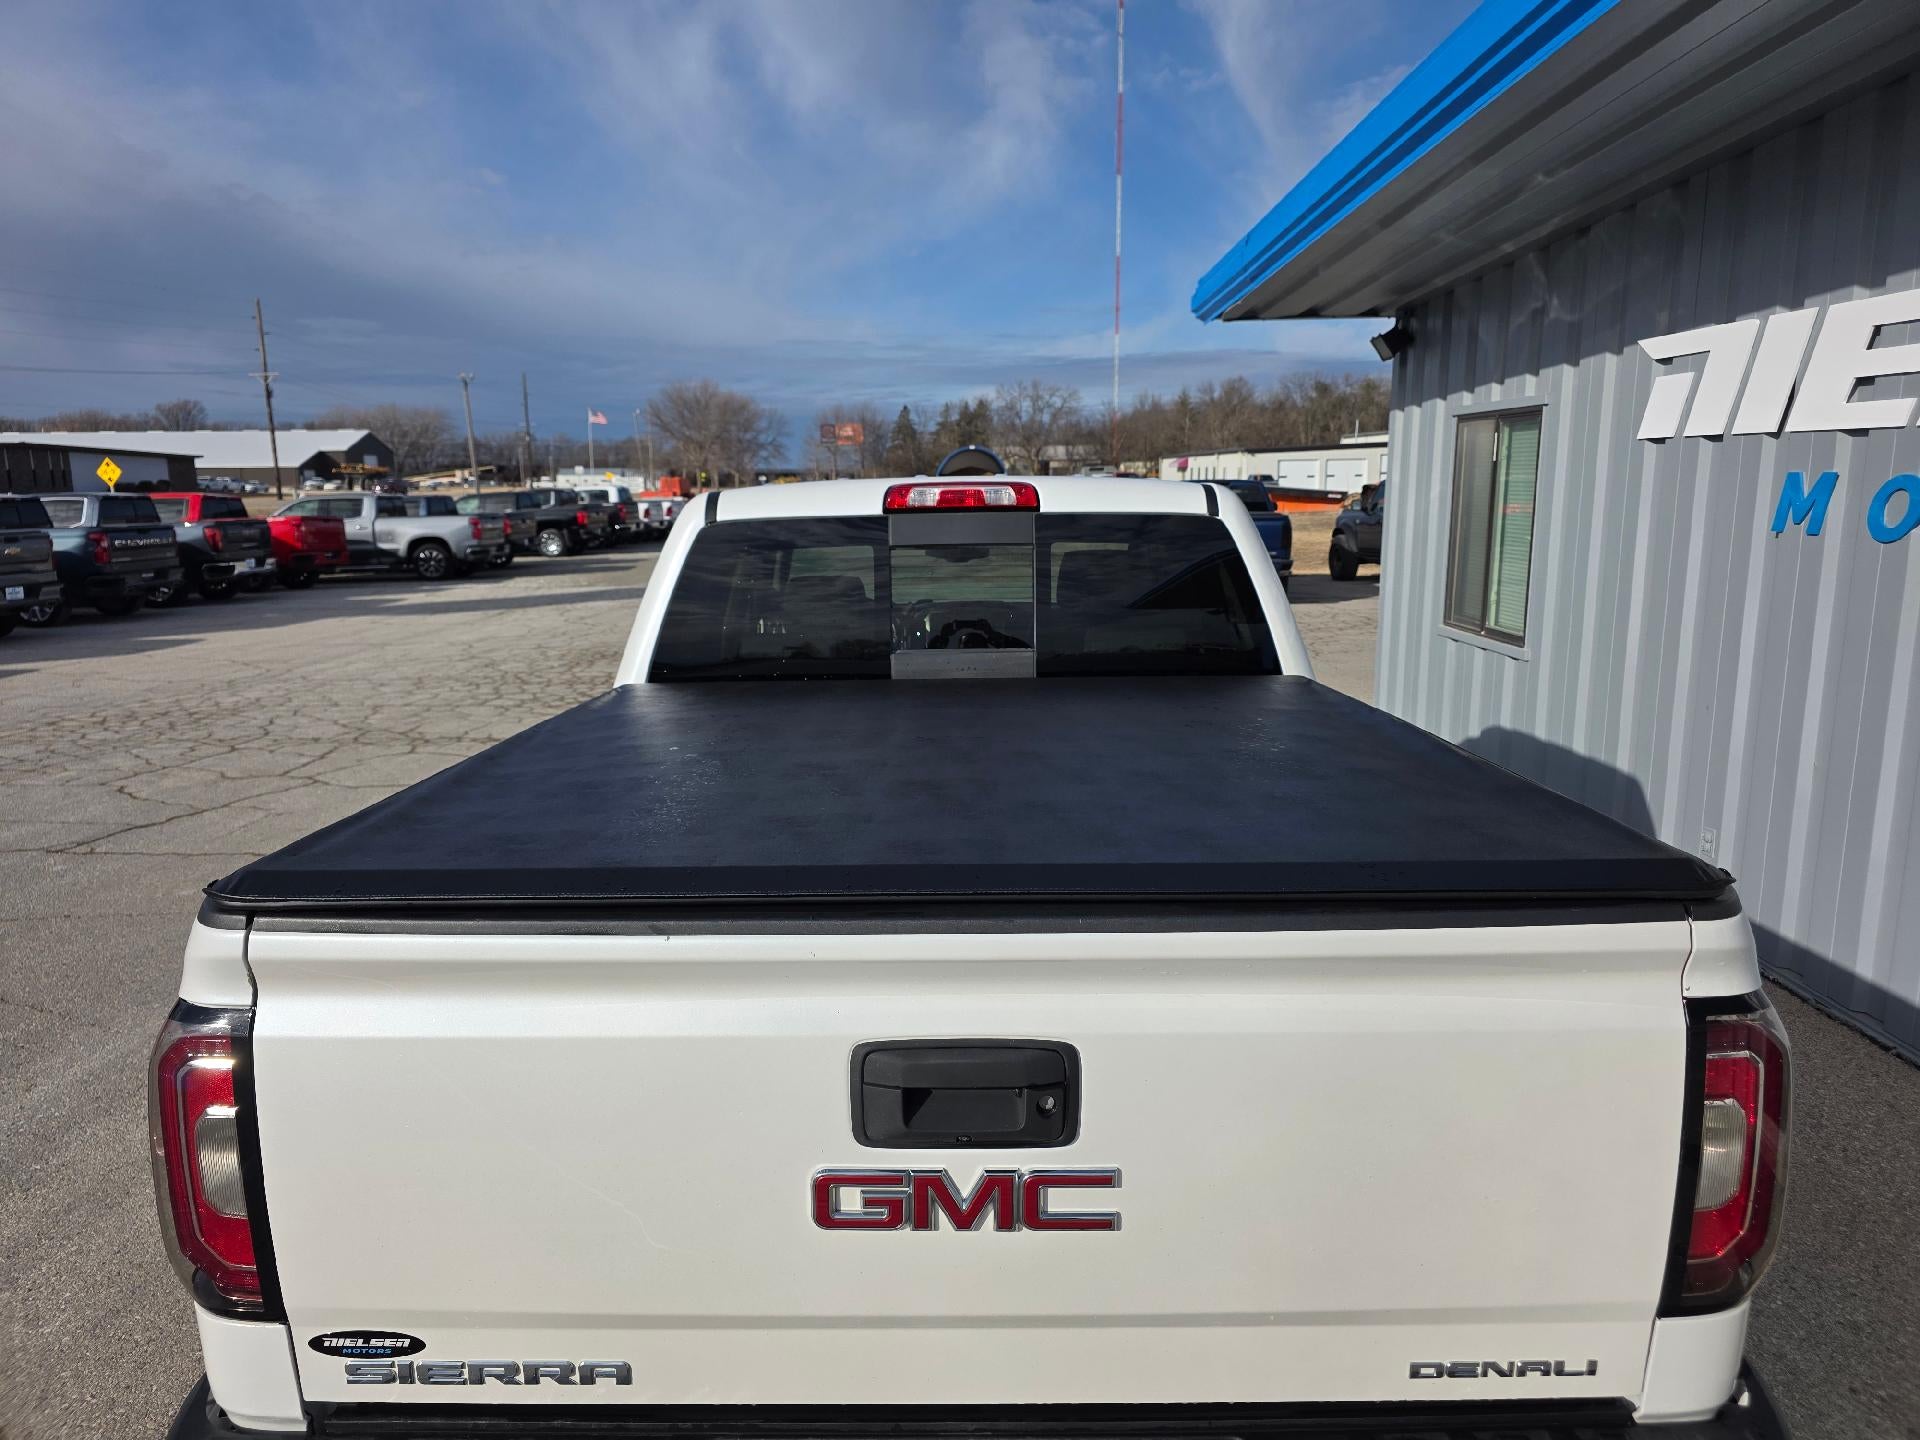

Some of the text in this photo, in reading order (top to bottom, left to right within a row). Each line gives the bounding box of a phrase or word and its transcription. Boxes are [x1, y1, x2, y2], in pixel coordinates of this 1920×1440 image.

[1771, 471, 1920, 544] MO
[811, 1166, 1122, 1232] GMC
[321, 1337, 411, 1348] NIELSEN
[344, 1359, 633, 1386] SIERRA
[1408, 1359, 1599, 1379] DENALI
